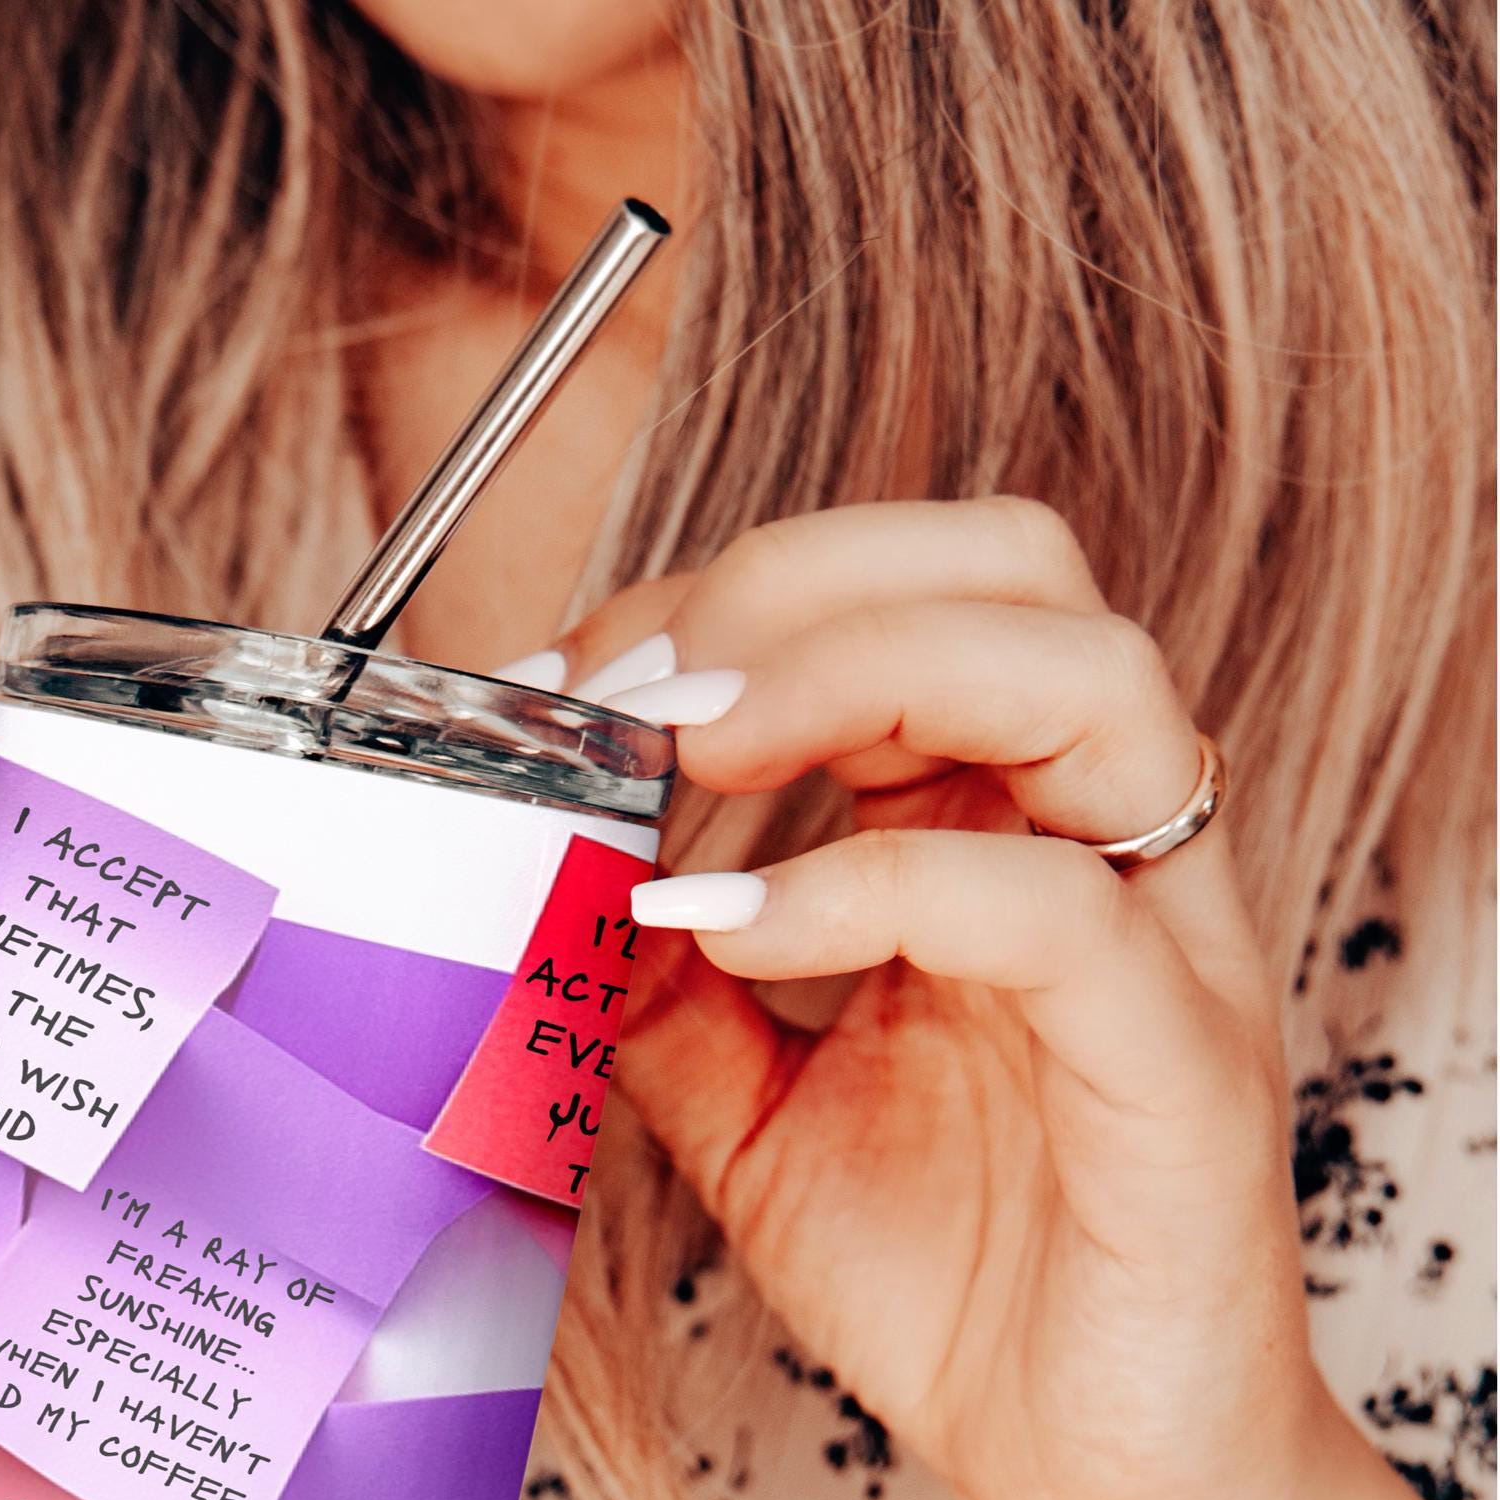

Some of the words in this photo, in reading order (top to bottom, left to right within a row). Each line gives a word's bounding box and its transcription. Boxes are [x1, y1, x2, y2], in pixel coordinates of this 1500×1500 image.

[14, 807, 30, 834] I
[43, 826, 211, 921] ACCEPT
[25, 875, 137, 944] THAT
[9, 990, 95, 1047] THE
[526, 957, 629, 1013] ACT
[21, 1059, 119, 1128] WISH
[100, 1188, 151, 1229] I'M
[162, 1219, 189, 1248] A
[202, 1237, 278, 1285] RAY
[286, 1278, 336, 1307] OF
[106, 1240, 276, 1338] FREAKING
[42, 1308, 252, 1420] ESPECIALLY
[77, 1274, 255, 1376] SUNSHINE...
[36, 1403, 90, 1442] MY
[92, 1380, 104, 1402] I
[119, 1396, 271, 1475] HAVEN'T
